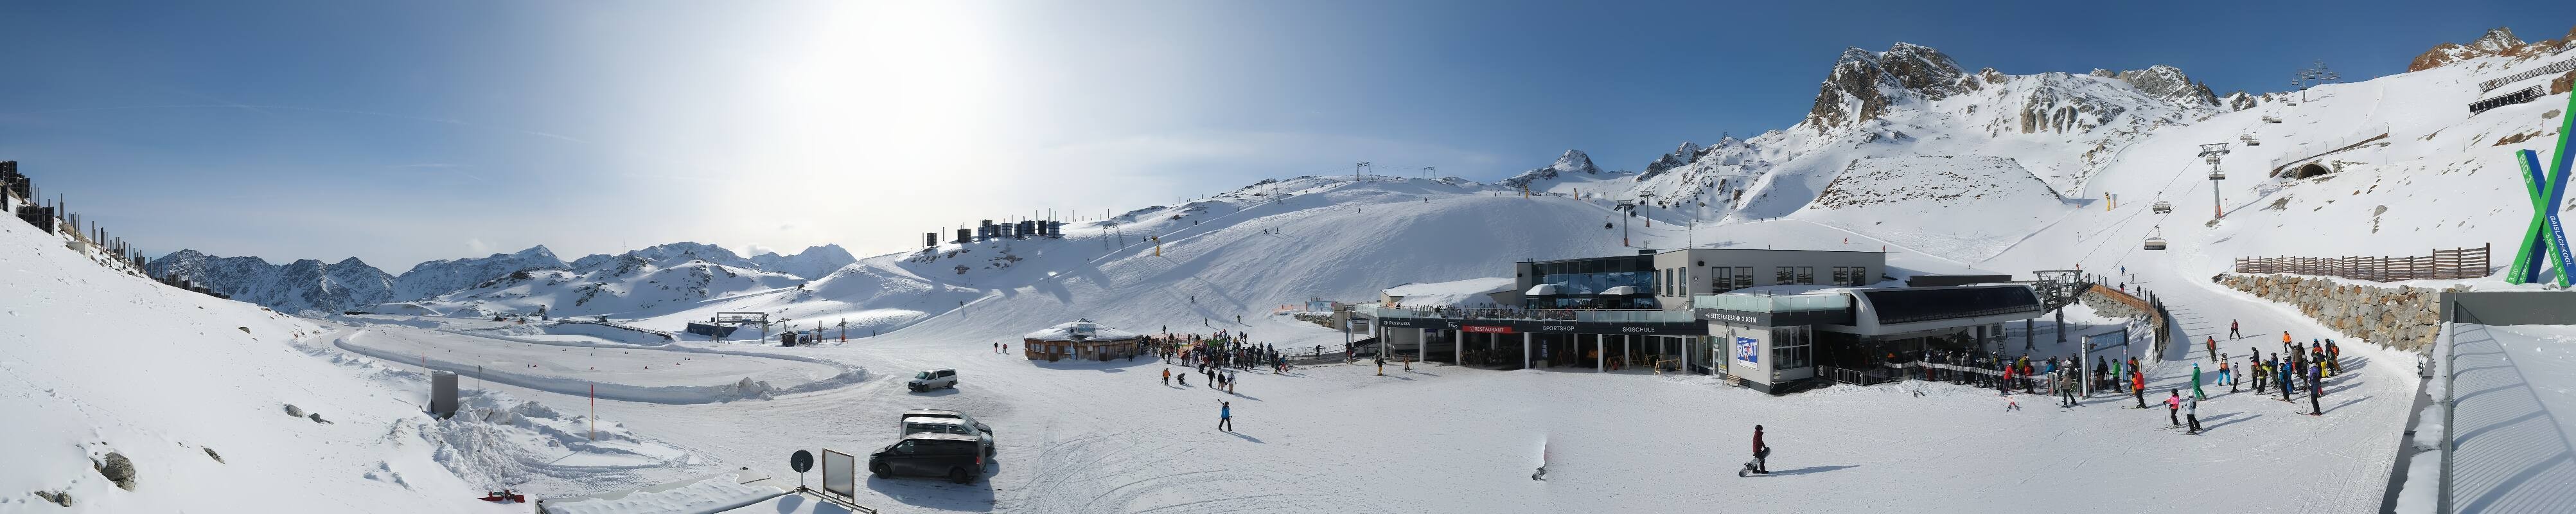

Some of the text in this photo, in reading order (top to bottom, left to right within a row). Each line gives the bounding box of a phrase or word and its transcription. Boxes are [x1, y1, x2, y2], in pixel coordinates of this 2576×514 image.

[2519, 153, 2532, 184] BIG 3
[2550, 215, 2572, 267] GAISLACHKOGL
[1737, 342, 1757, 357] RENT
